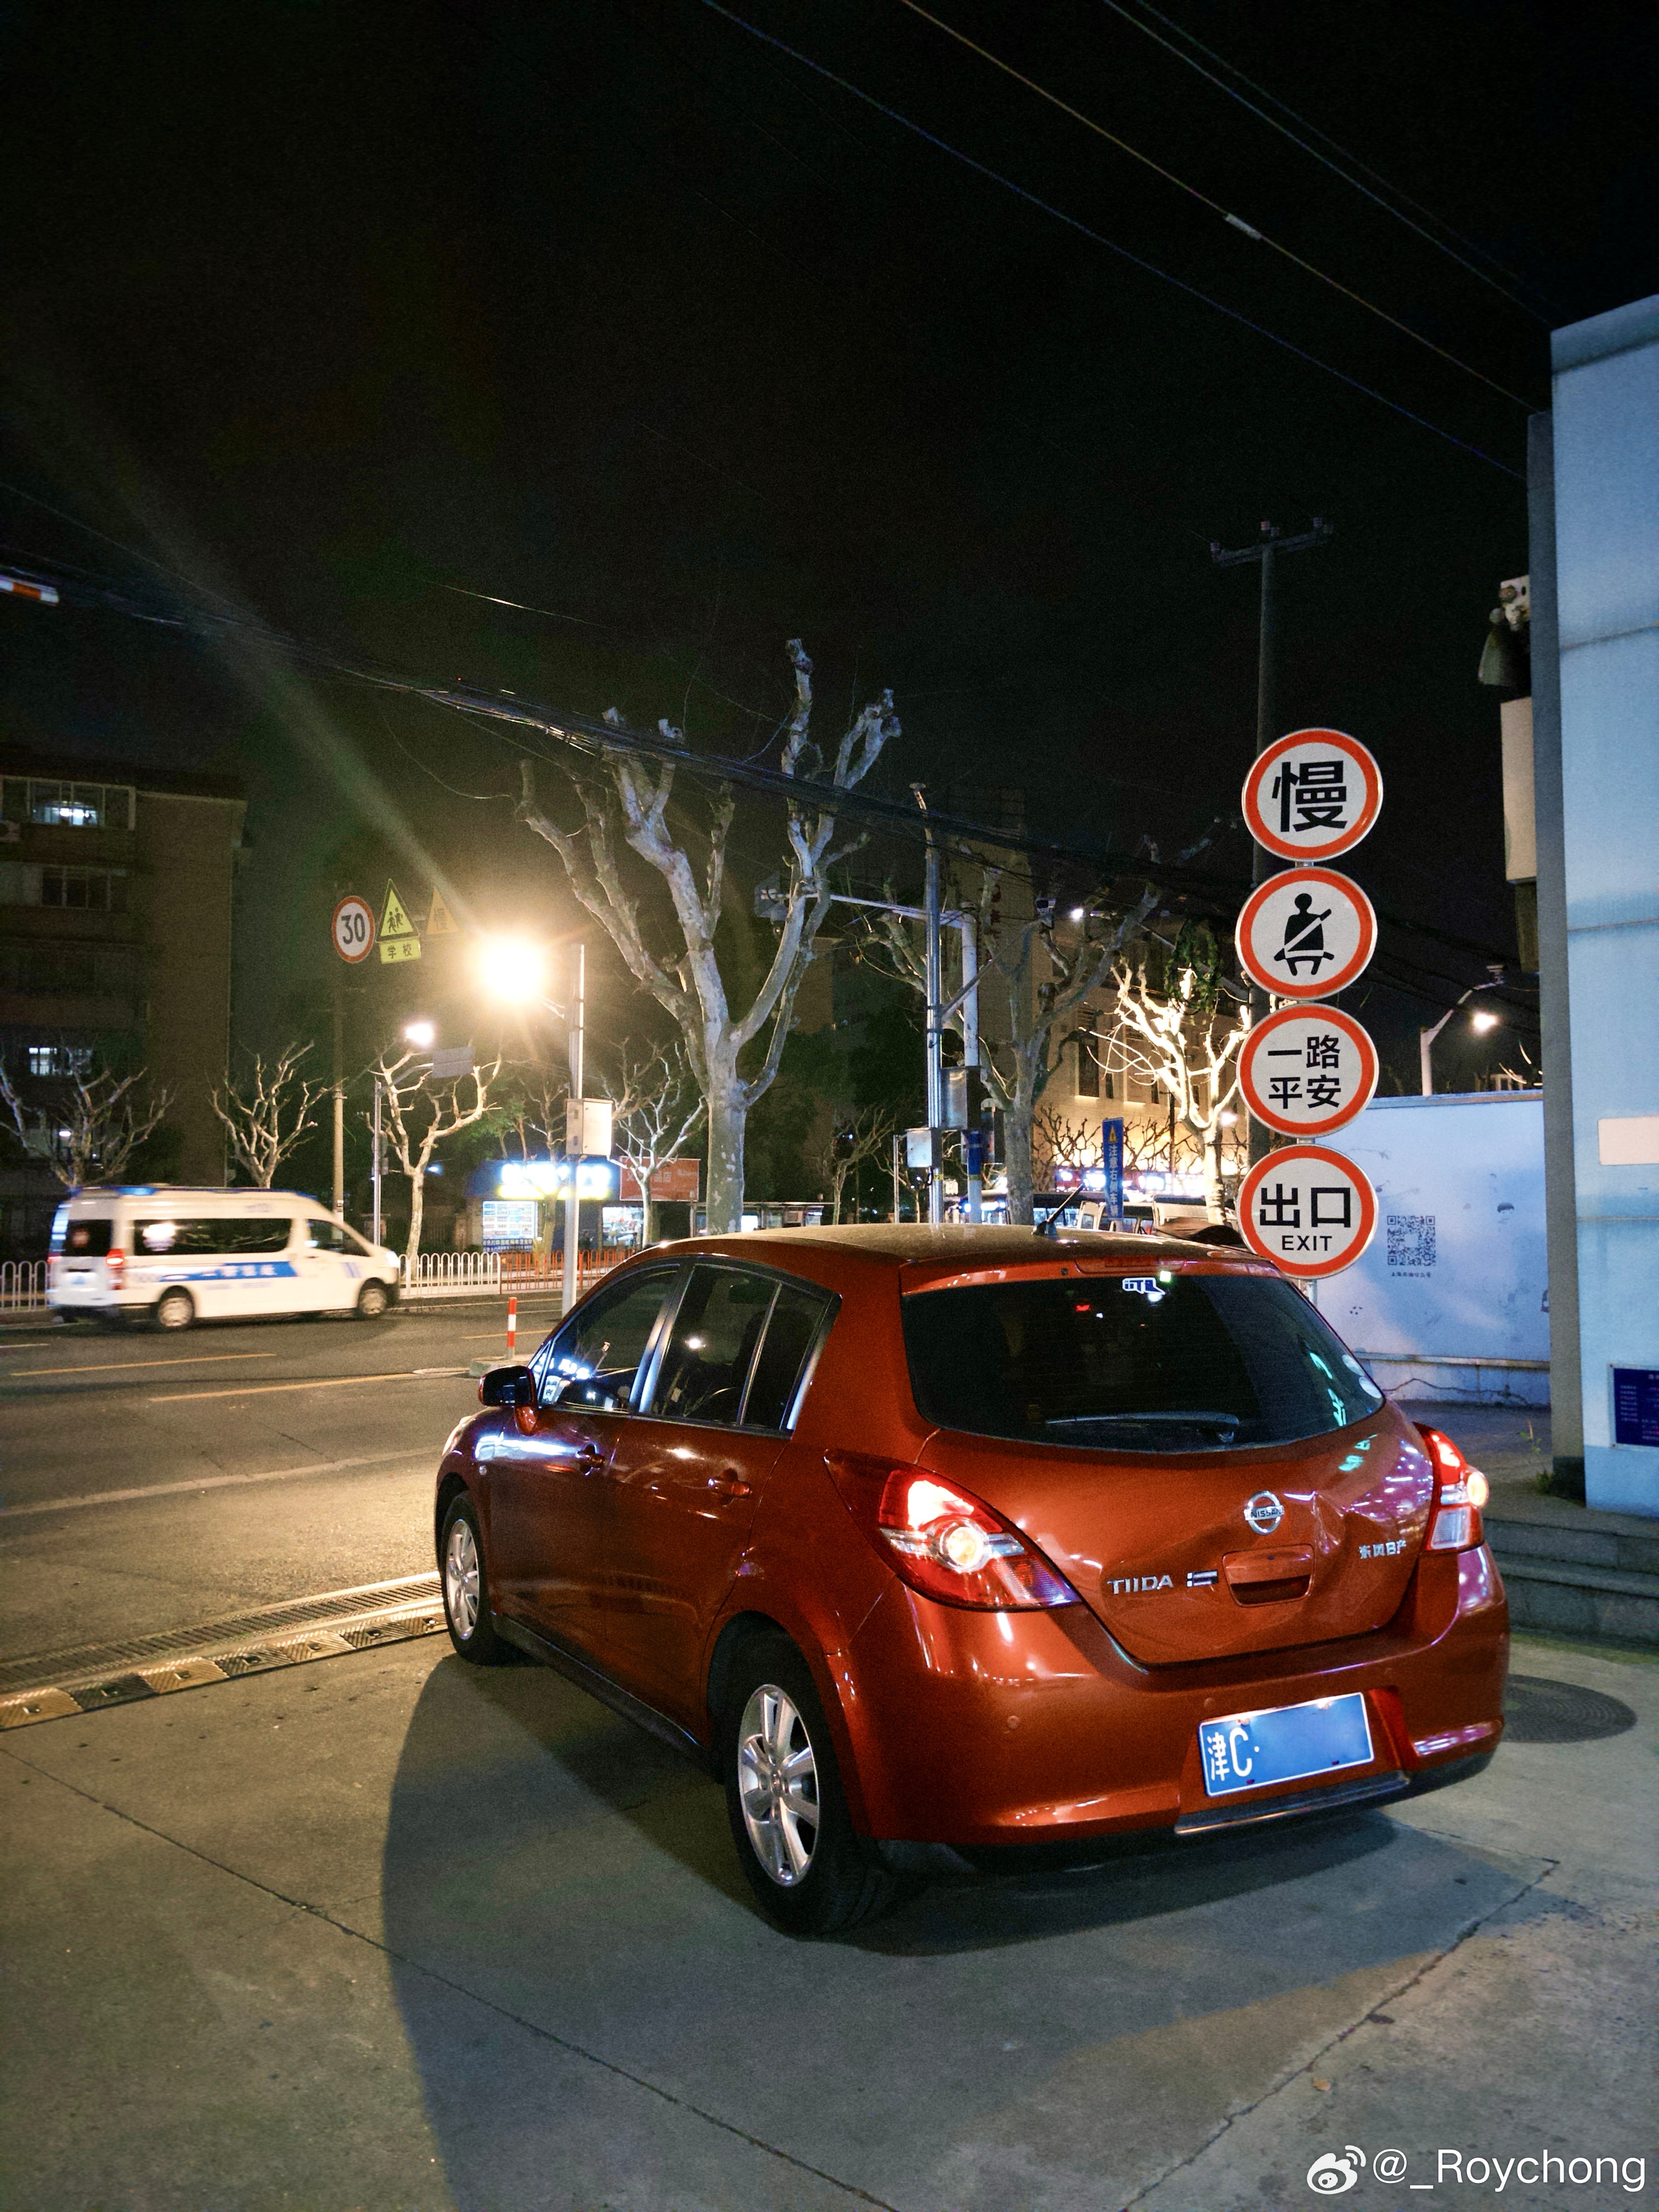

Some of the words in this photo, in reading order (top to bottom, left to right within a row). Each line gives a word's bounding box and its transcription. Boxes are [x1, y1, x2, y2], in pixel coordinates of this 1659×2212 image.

[1272, 760, 1348, 832] 慢
[341, 913, 365, 945] 30
[387, 943, 413, 958] 学校
[1267, 1034, 1341, 1069] 一路
[1268, 1074, 1341, 1109] 平安
[1260, 1183, 1351, 1229] 出口
[1282, 1235, 1333, 1251] EXIT
[1251, 1508, 1282, 1518] NISSAN
[1358, 1539, 1407, 1559] 东风日产
[1107, 1575, 1174, 1594] TIIDA
